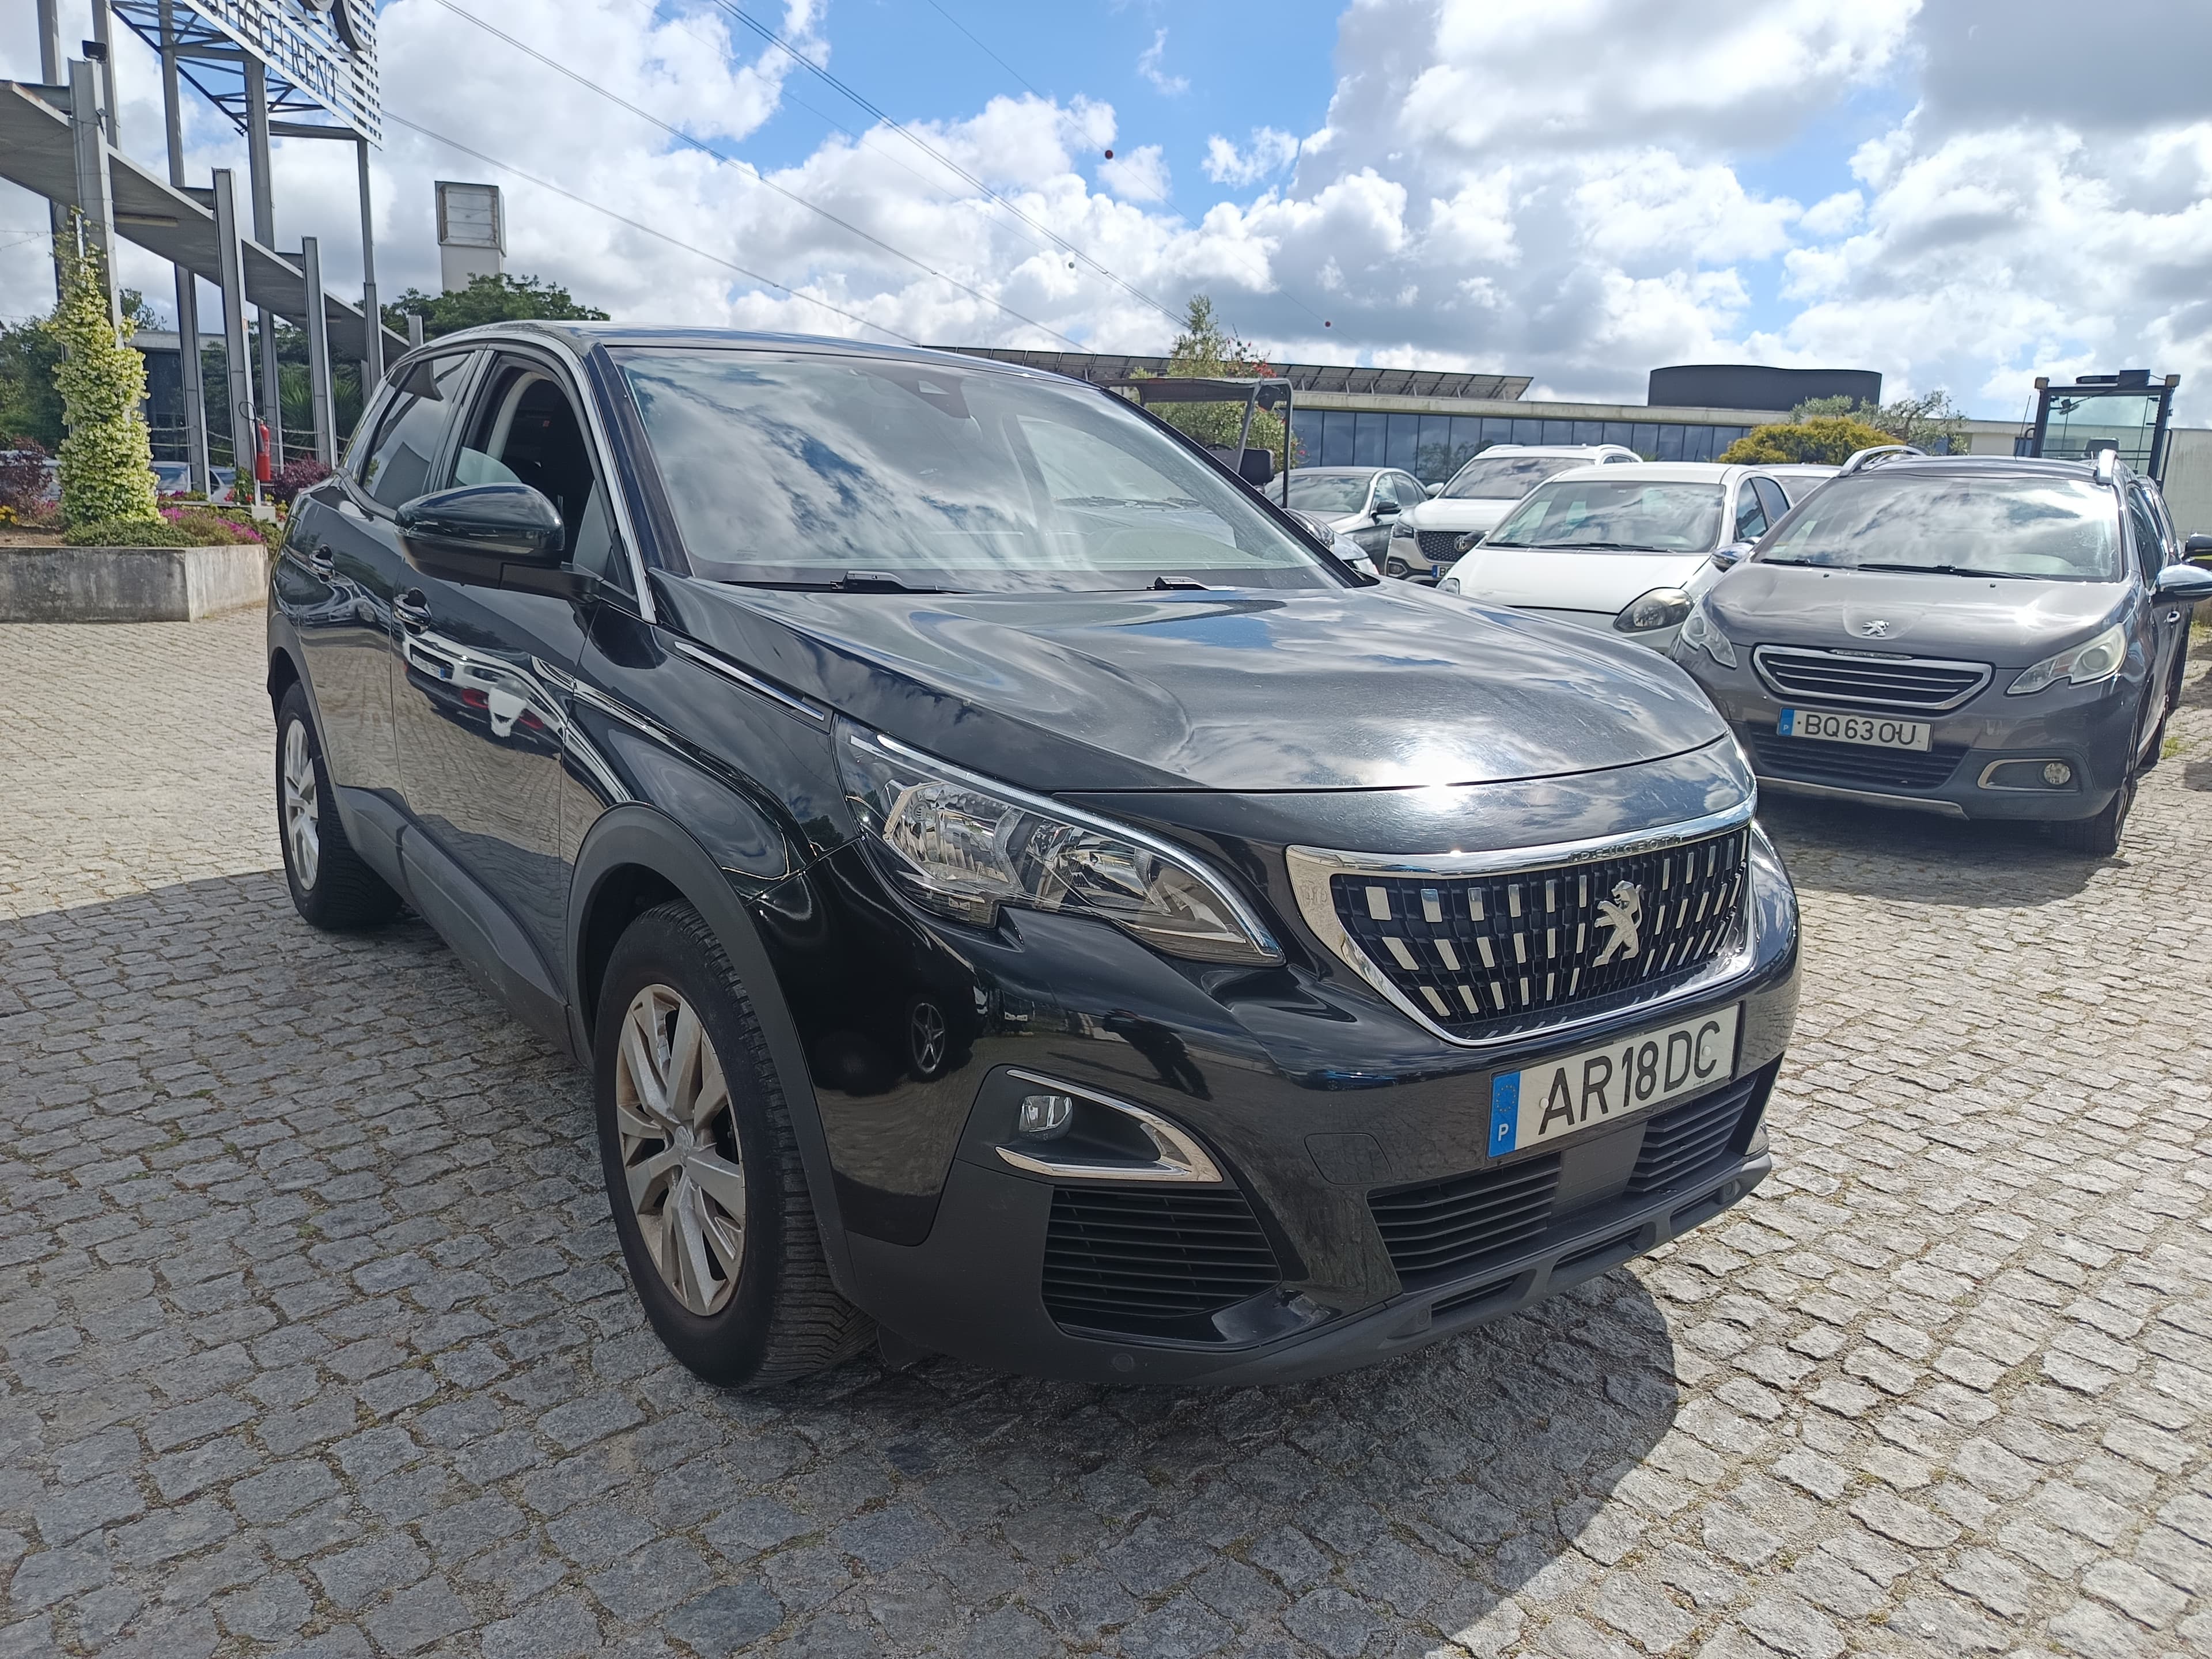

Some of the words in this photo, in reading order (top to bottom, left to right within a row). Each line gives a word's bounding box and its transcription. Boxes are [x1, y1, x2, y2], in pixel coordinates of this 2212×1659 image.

[289, 31, 339, 107] RENT
[1580, 838, 1670, 860] PEUGEOT
[1498, 1123, 1509, 1142] P
